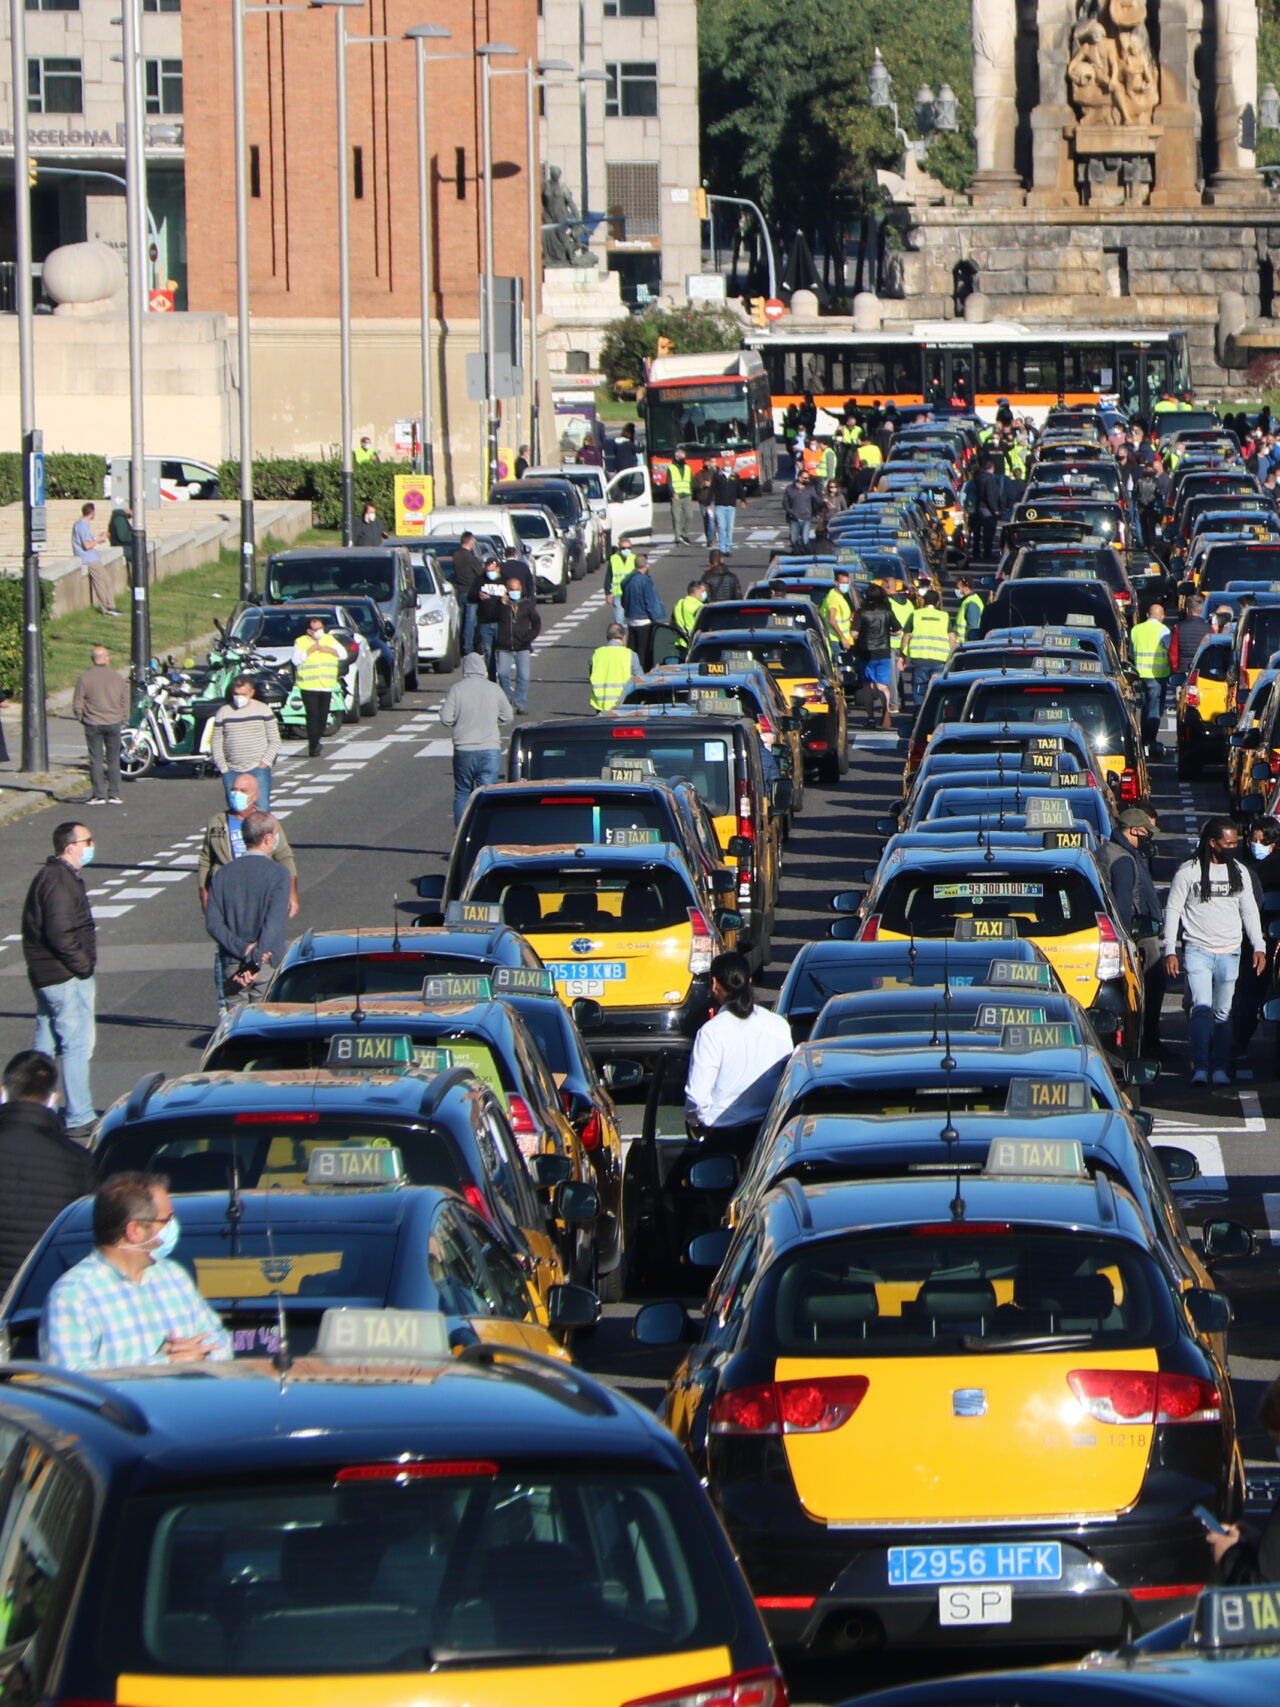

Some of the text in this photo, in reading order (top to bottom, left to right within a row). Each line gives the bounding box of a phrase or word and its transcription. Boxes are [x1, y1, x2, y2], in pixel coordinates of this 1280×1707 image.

[1054, 636, 1071, 646] TAXI
[707, 663, 724, 673] TAXI
[700, 690, 718, 699] TAXI
[1046, 709, 1063, 720] TAXI
[1037, 738, 1058, 750] TAXI
[1032, 754, 1054, 767] TAXI
[612, 769, 633, 781] TAXI
[1059, 774, 1079, 786] TAXI
[1041, 812, 1064, 826] TAXI
[629, 831, 650, 844] TAXI
[1057, 833, 1082, 848] TAXI
[968, 884, 980, 895] 93
[983, 884, 1000, 895] 300
[463, 905, 488, 921] TAXI
[974, 921, 1003, 936] TAXI
[513, 970, 540, 987] TAXI
[550, 964, 622, 979] 0519 KWB
[1011, 963, 1041, 982] TAXI
[446, 978, 478, 997] TAXI
[1001, 1007, 1030, 1025] TAXI
[1026, 1026, 1061, 1045] TAXI
[355, 1037, 392, 1060] TAXI
[1031, 1084, 1068, 1105] TAXI
[1020, 1142, 1062, 1168] TAXI
[340, 1151, 381, 1175] TAXI
[362, 1316, 420, 1348] TAXI
[1109, 1434, 1146, 1448] 1218
[910, 1547, 1054, 1579] 2956 HFK
